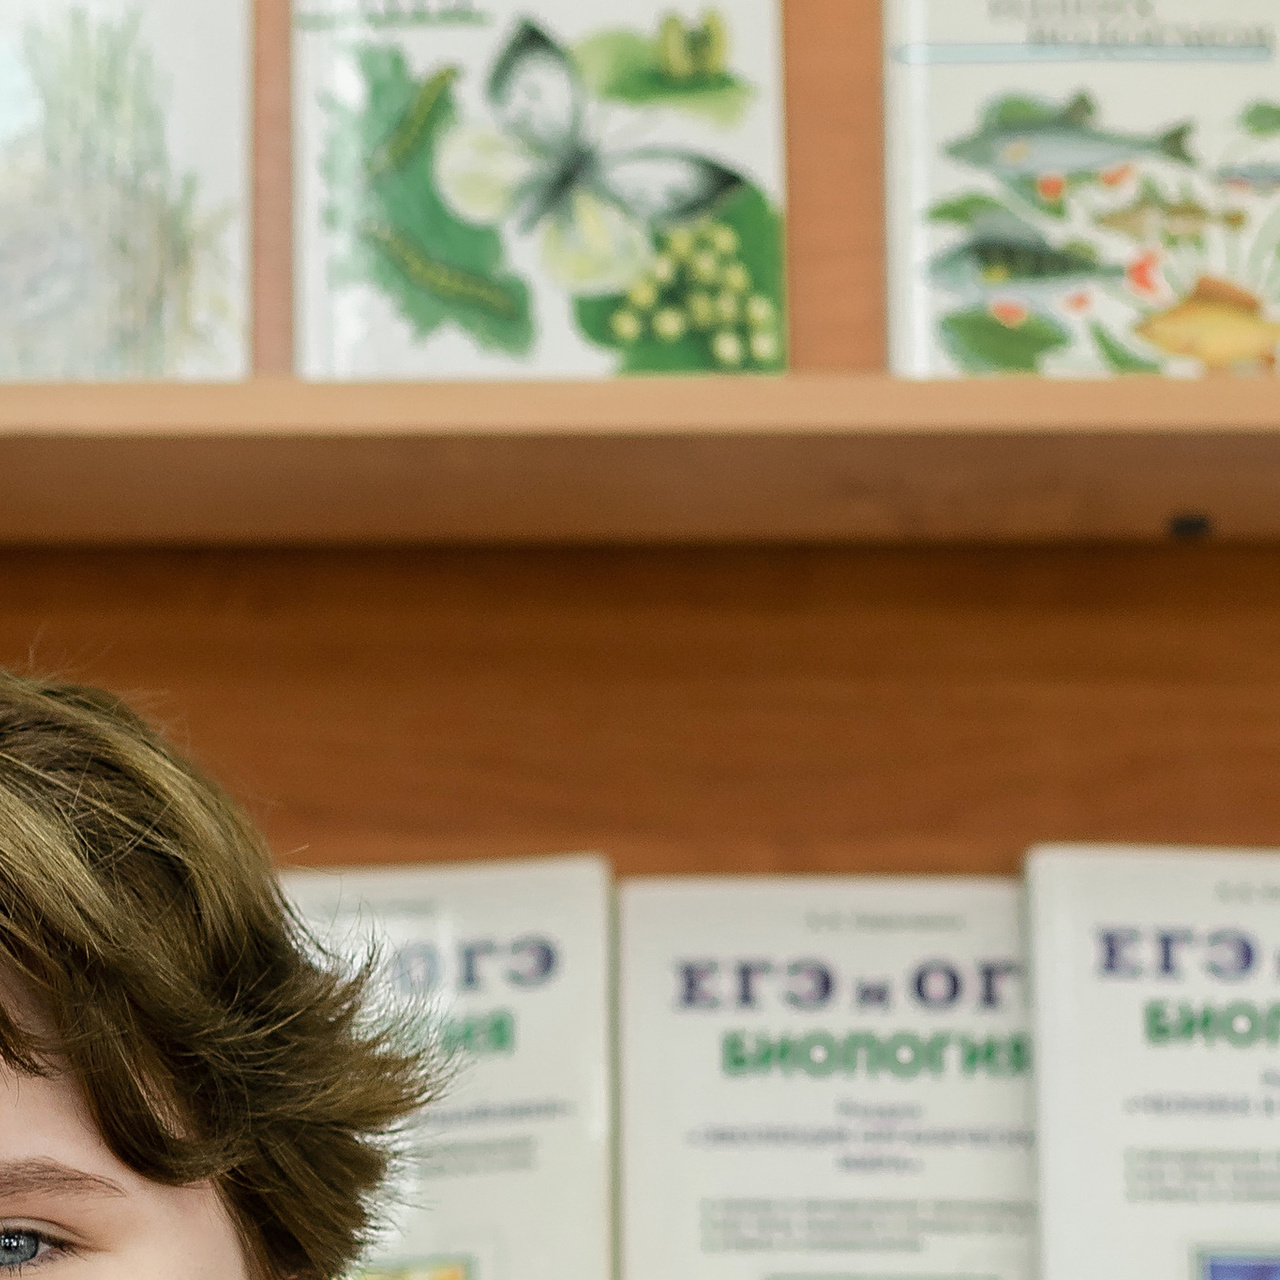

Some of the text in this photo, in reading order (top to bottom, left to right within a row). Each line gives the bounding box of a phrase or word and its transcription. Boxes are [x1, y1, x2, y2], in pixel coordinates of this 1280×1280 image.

[1096, 926, 1261, 981] ЕГЭ
[673, 957, 836, 1012] ЕГЭ
[721, 1029, 1032, 1079] БИОЛОГИЯ
